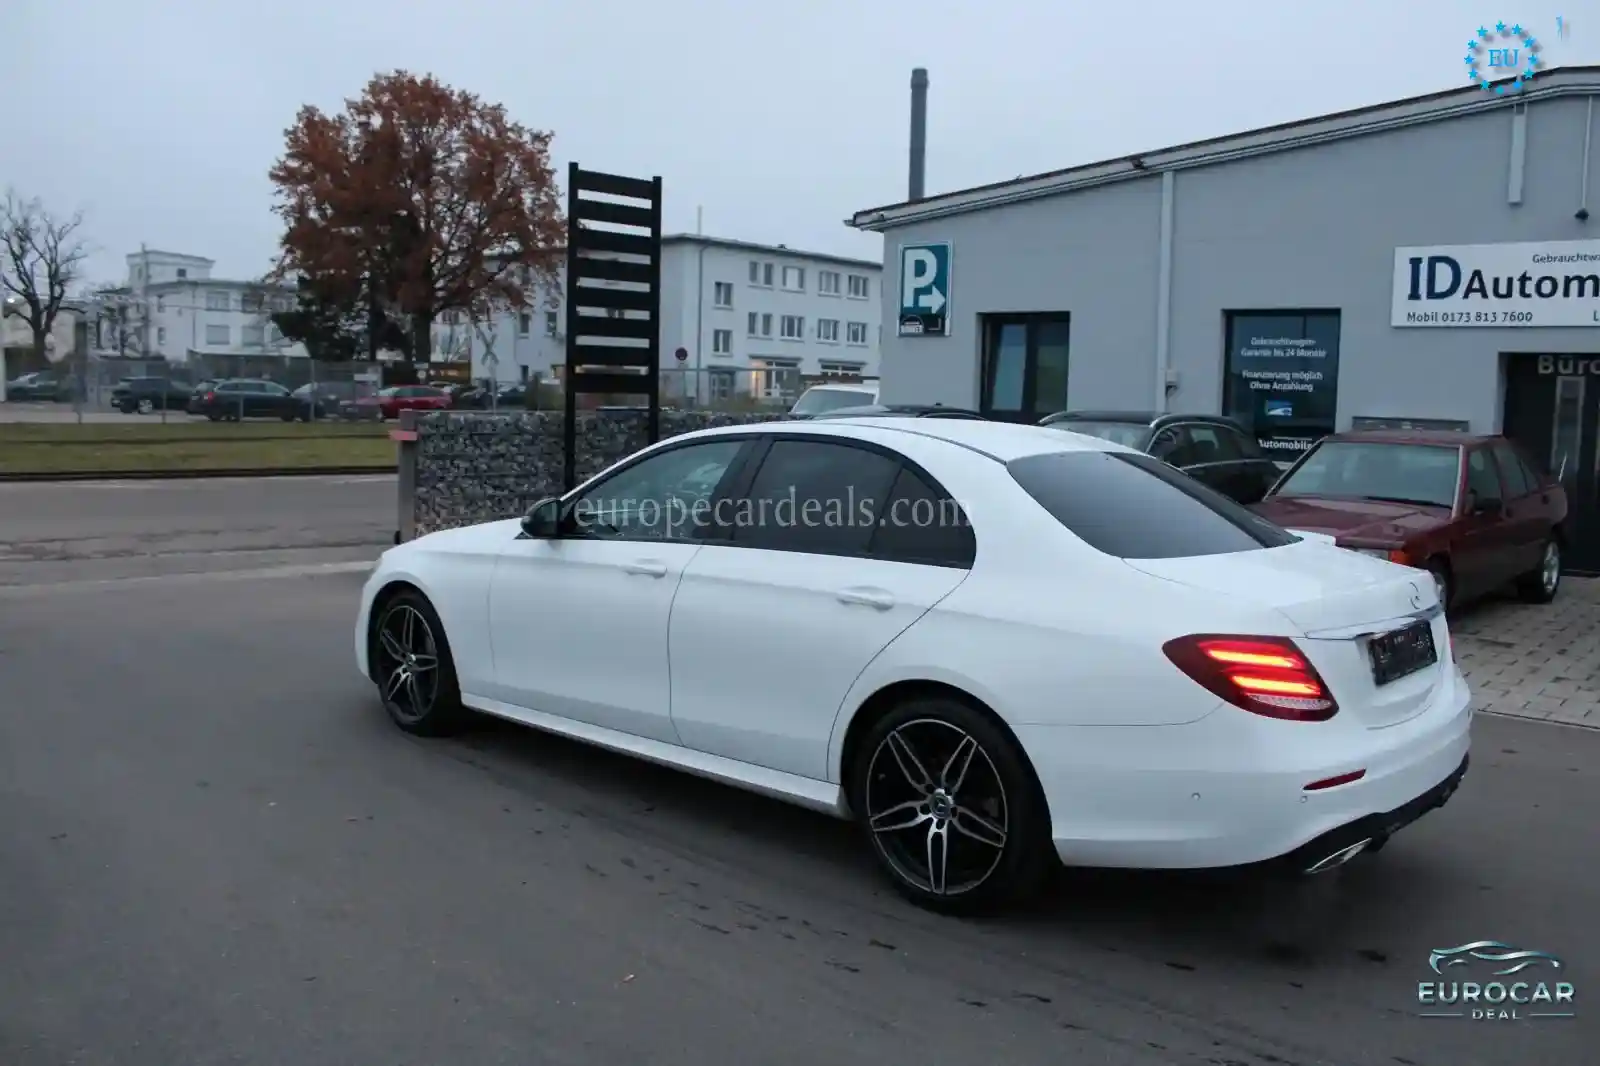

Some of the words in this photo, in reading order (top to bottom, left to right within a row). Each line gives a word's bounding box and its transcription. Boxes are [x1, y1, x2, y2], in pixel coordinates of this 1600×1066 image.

[903, 248, 937, 308] P
[1407, 311, 1438, 323] Mobil
[1442, 311, 1471, 323] 0173
[1475, 311, 1497, 324] 813
[1502, 311, 1533, 323] 7600
[1242, 369, 1291, 380] Finanzierung
[1250, 381, 1271, 390] Ohne
[1272, 381, 1314, 393] Anzahlung
